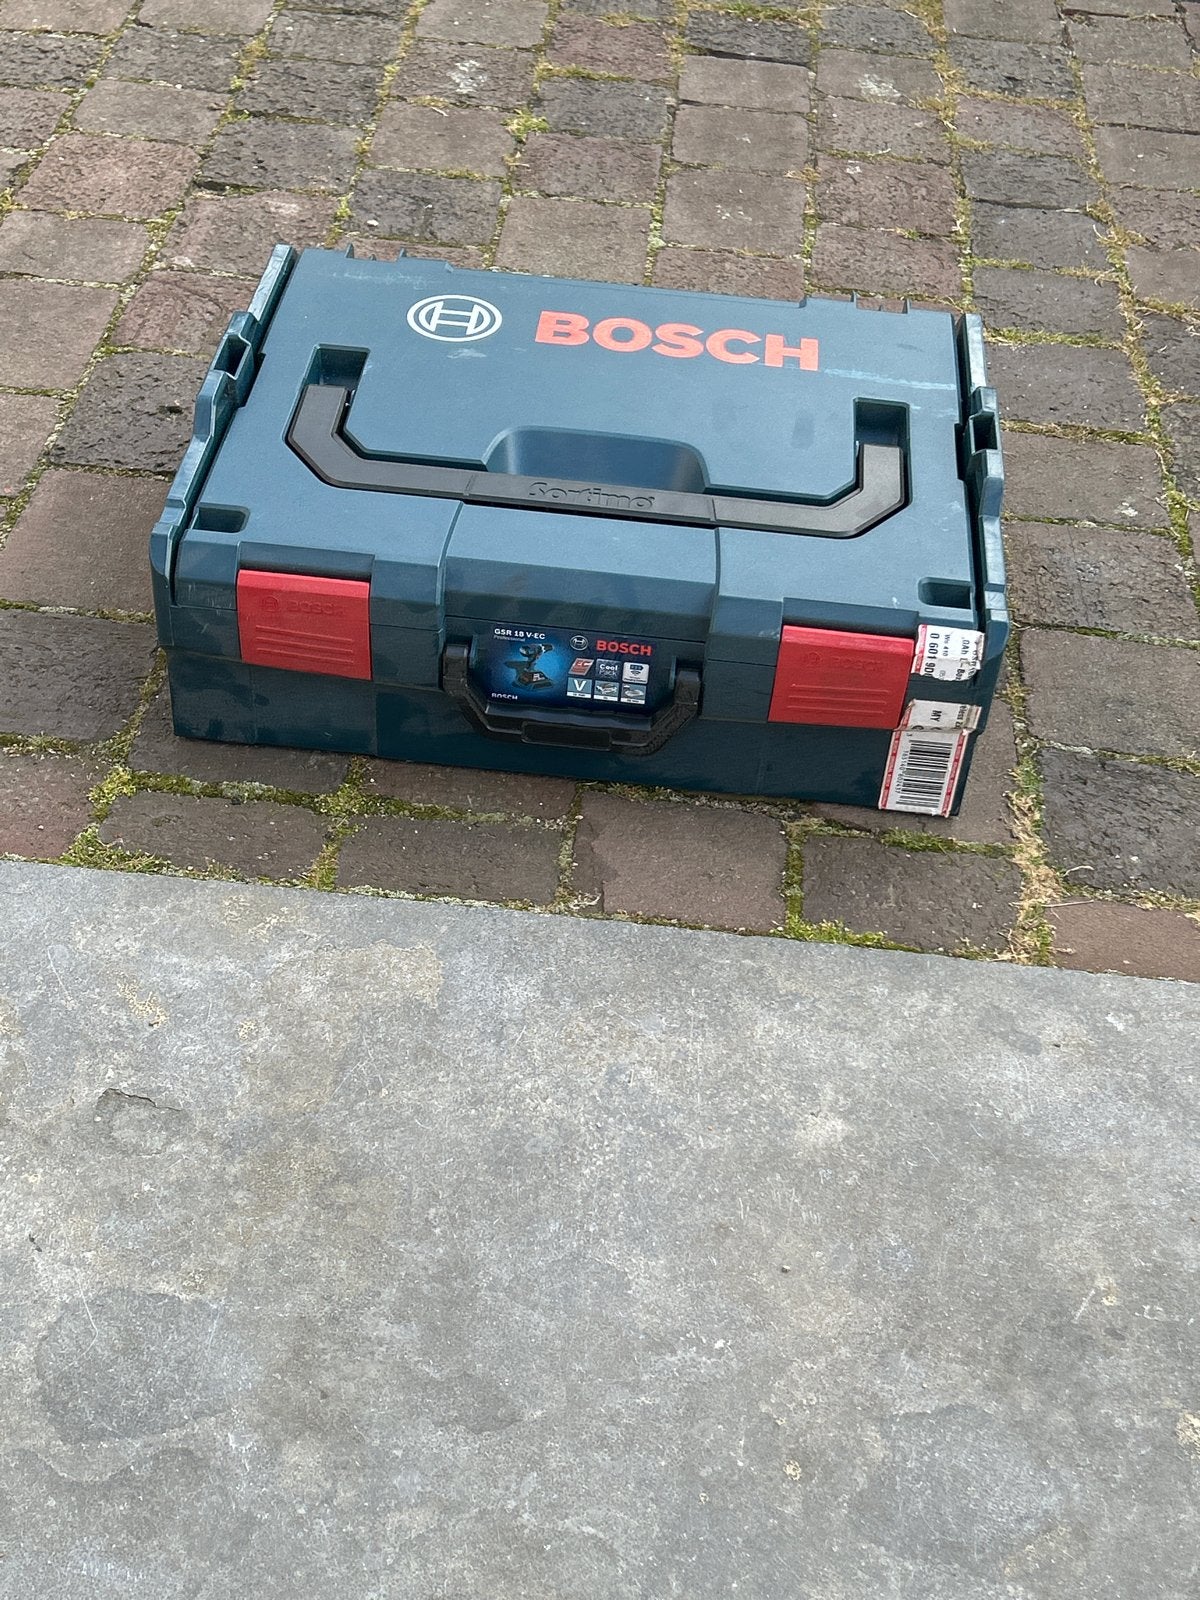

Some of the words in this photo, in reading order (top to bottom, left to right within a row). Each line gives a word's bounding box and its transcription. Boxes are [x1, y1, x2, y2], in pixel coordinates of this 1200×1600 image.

[535, 310, 819, 371] BOSCH
[529, 481, 653, 509] Sortimo
[494, 628, 512, 636] GSR
[514, 630, 525, 638] 18
[596, 639, 652, 656] BOSCH
[927, 642, 939, 660] 601
[600, 663, 618, 671] Cool
[573, 679, 587, 692] V
[930, 710, 942, 722] MY
